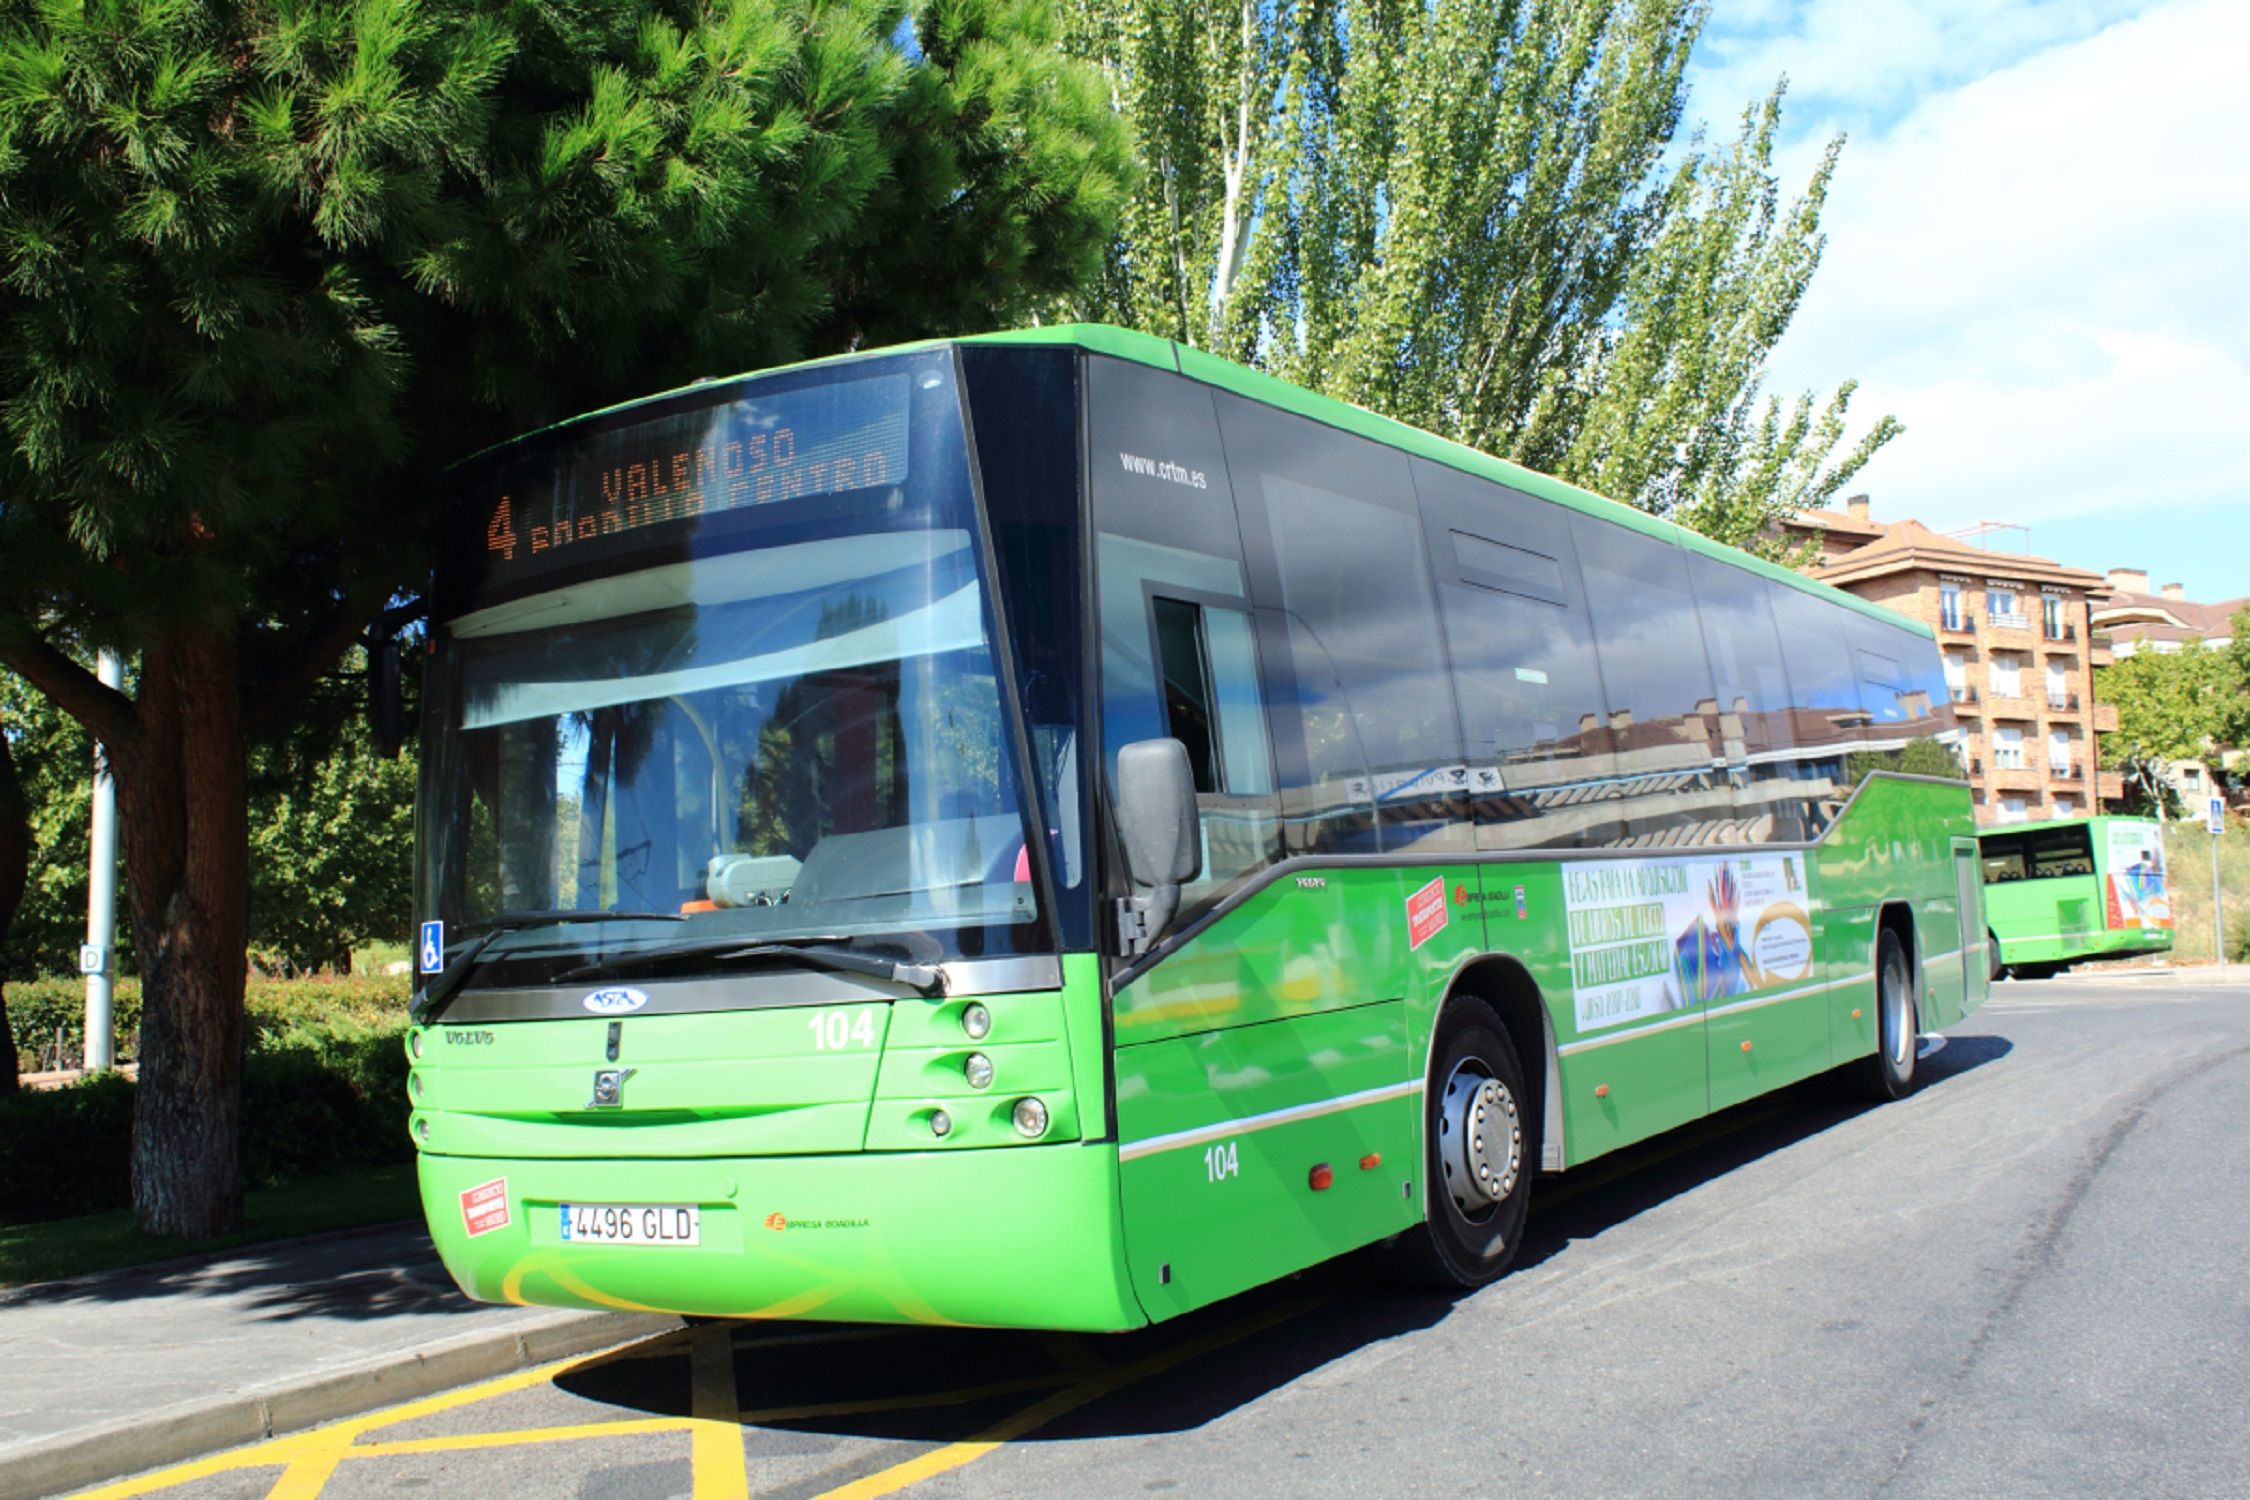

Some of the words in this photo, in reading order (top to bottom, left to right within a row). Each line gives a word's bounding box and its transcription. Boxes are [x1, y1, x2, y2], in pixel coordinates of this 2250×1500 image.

[602, 428, 795, 504] VALENOSO
[487, 495, 517, 560] 4
[446, 1030, 495, 1045] VOLVO
[808, 1008, 874, 1051] 104
[1205, 1142, 1239, 1183] 104
[577, 1207, 633, 1238] 4496
[643, 1208, 690, 1239] GLD
